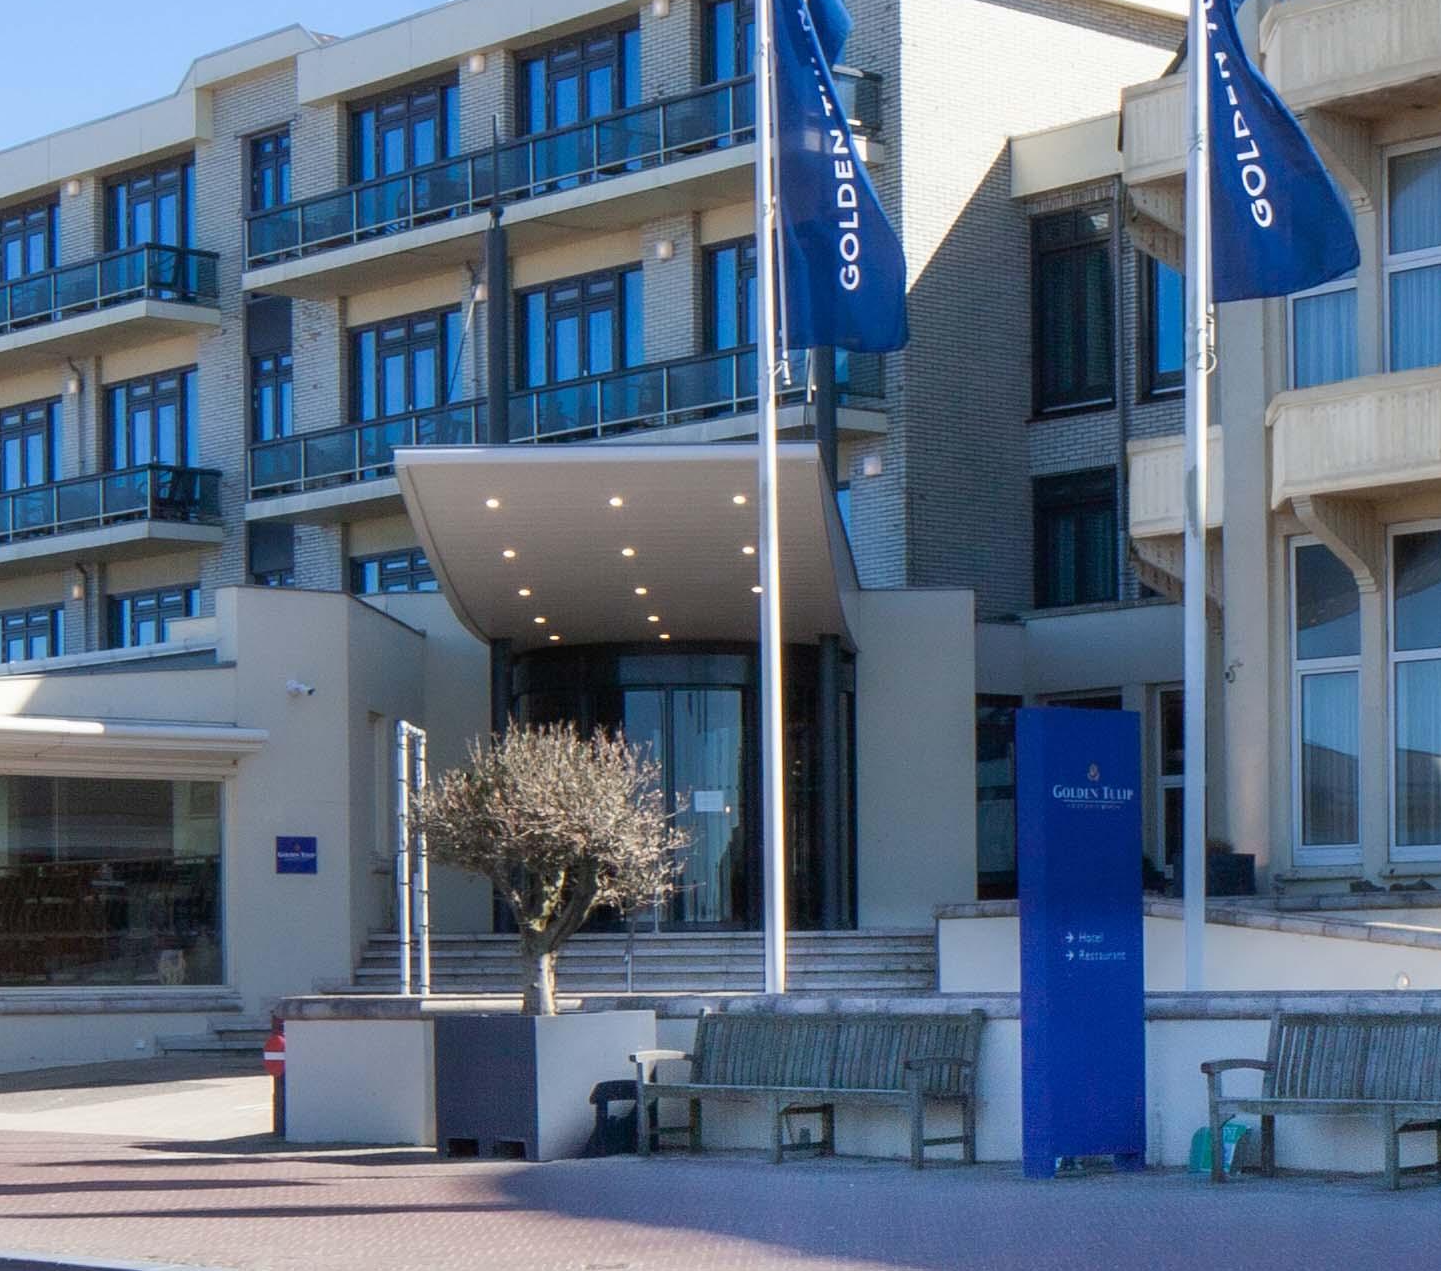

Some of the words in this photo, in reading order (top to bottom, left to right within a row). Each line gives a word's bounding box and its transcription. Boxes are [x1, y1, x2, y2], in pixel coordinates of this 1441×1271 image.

[829, 129, 860, 291] GOLDEN
[1052, 784, 1099, 800] GOLDEN
[1102, 786, 1135, 801] TULIP
